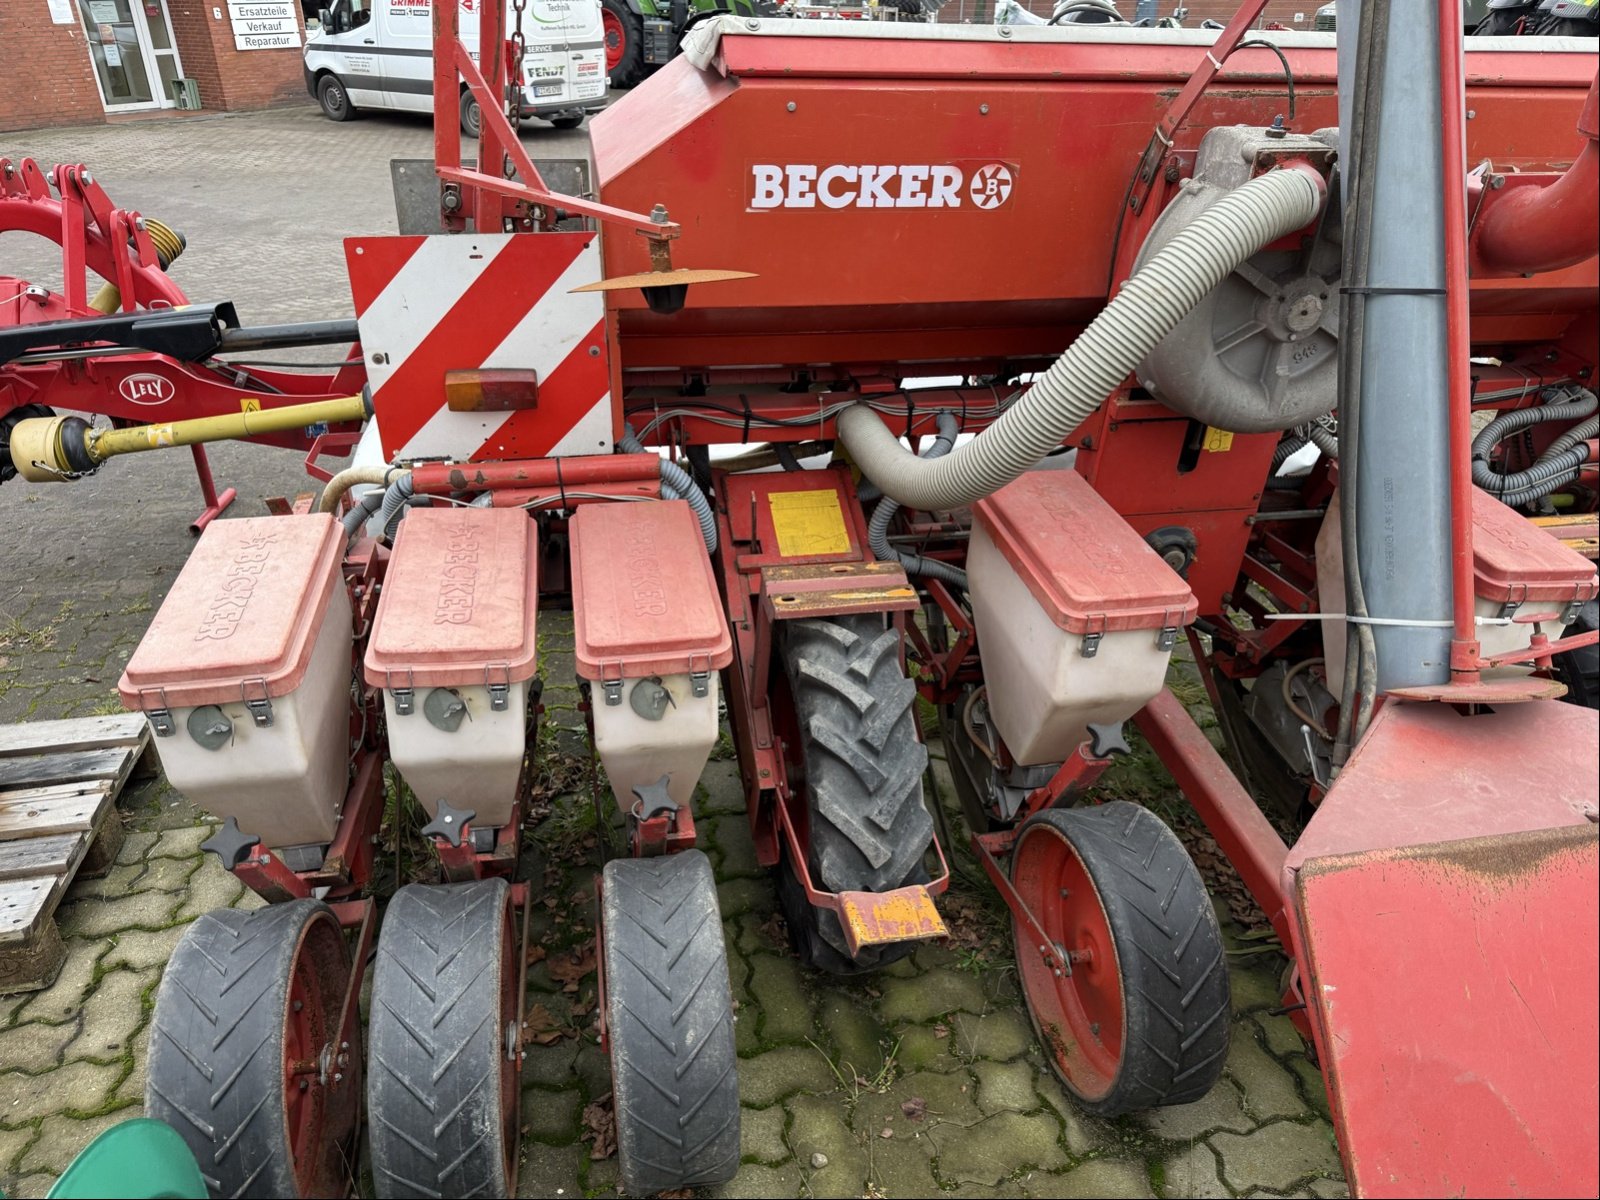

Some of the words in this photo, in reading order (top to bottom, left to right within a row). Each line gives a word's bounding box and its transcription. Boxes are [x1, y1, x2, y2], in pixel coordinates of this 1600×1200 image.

[213, 7, 223, 20] 6
[238, 6, 288, 17] Ersatzteile
[547, 4, 571, 12] Technik
[246, 20, 282, 31] Verkauf
[244, 36, 290, 47] Reparatur
[527, 45, 553, 53] SERVICE
[528, 65, 565, 78] FENDT
[751, 164, 963, 209] BECKER
[129, 379, 163, 400] LELY
[434, 541, 479, 625] BECKER
[194, 551, 271, 641] BECKER
